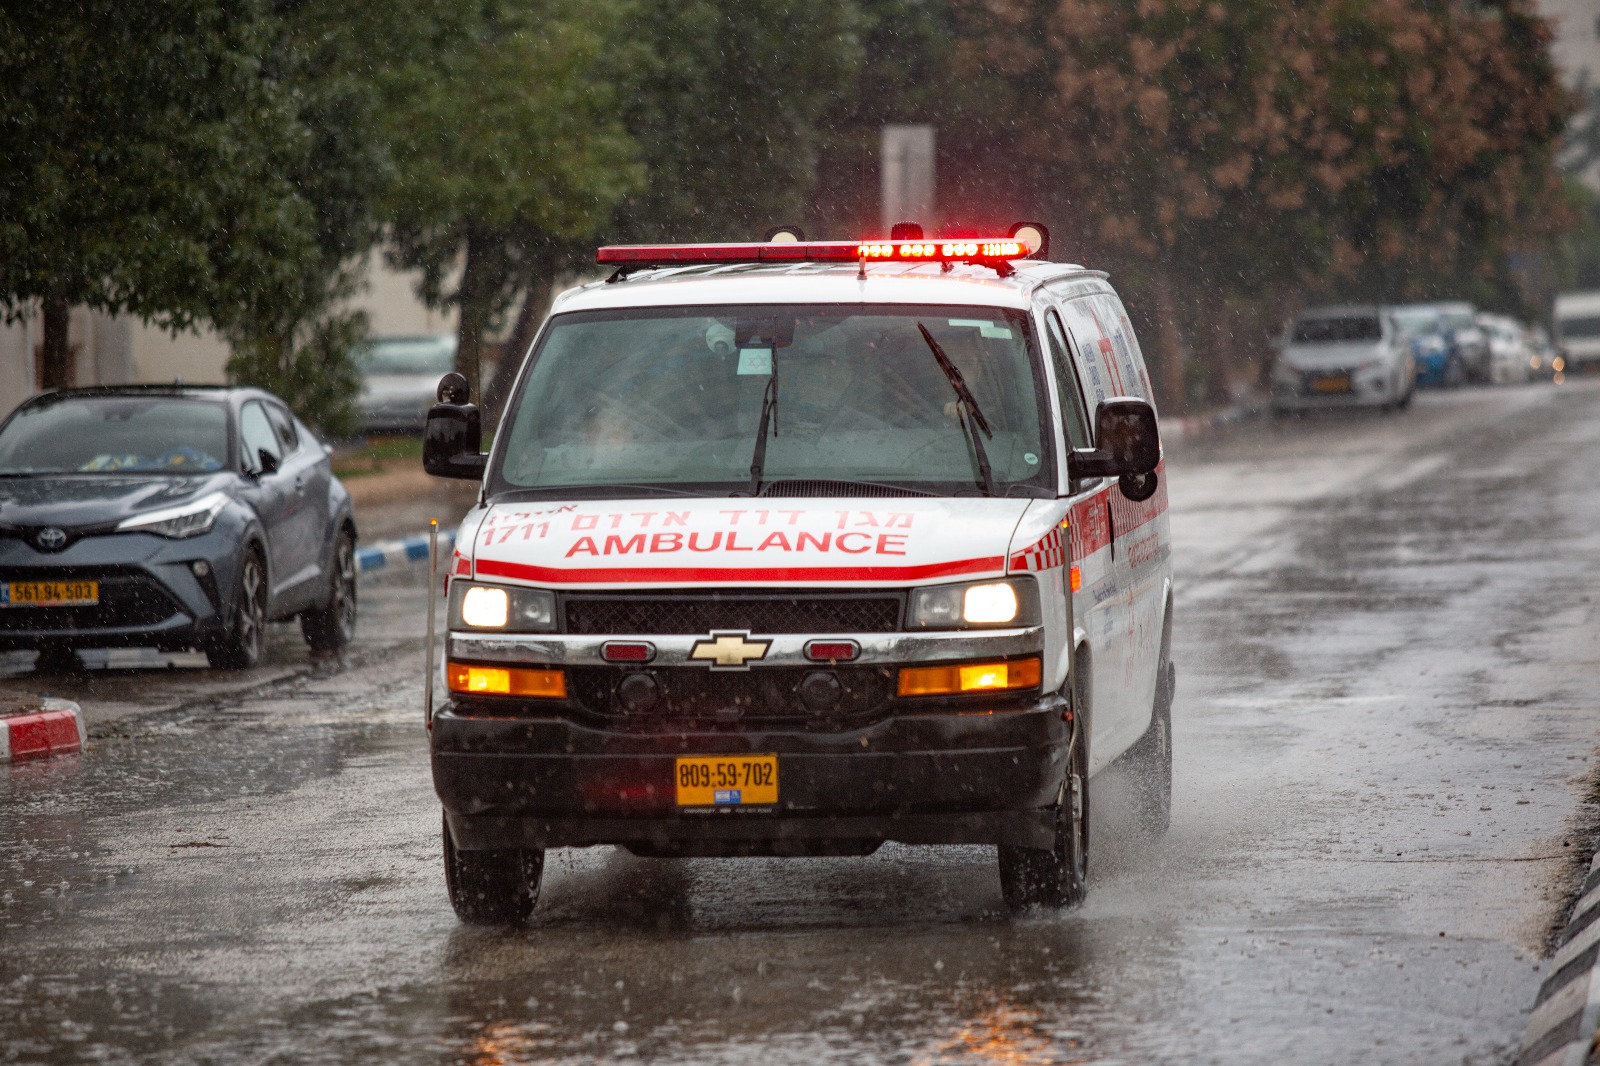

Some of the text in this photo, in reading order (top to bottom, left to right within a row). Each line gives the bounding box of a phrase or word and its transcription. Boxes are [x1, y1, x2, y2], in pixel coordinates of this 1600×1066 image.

[570, 510, 915, 531] מגן דוד אדום
[482, 521, 550, 546] 1711
[564, 531, 909, 558] AMBULANCE
